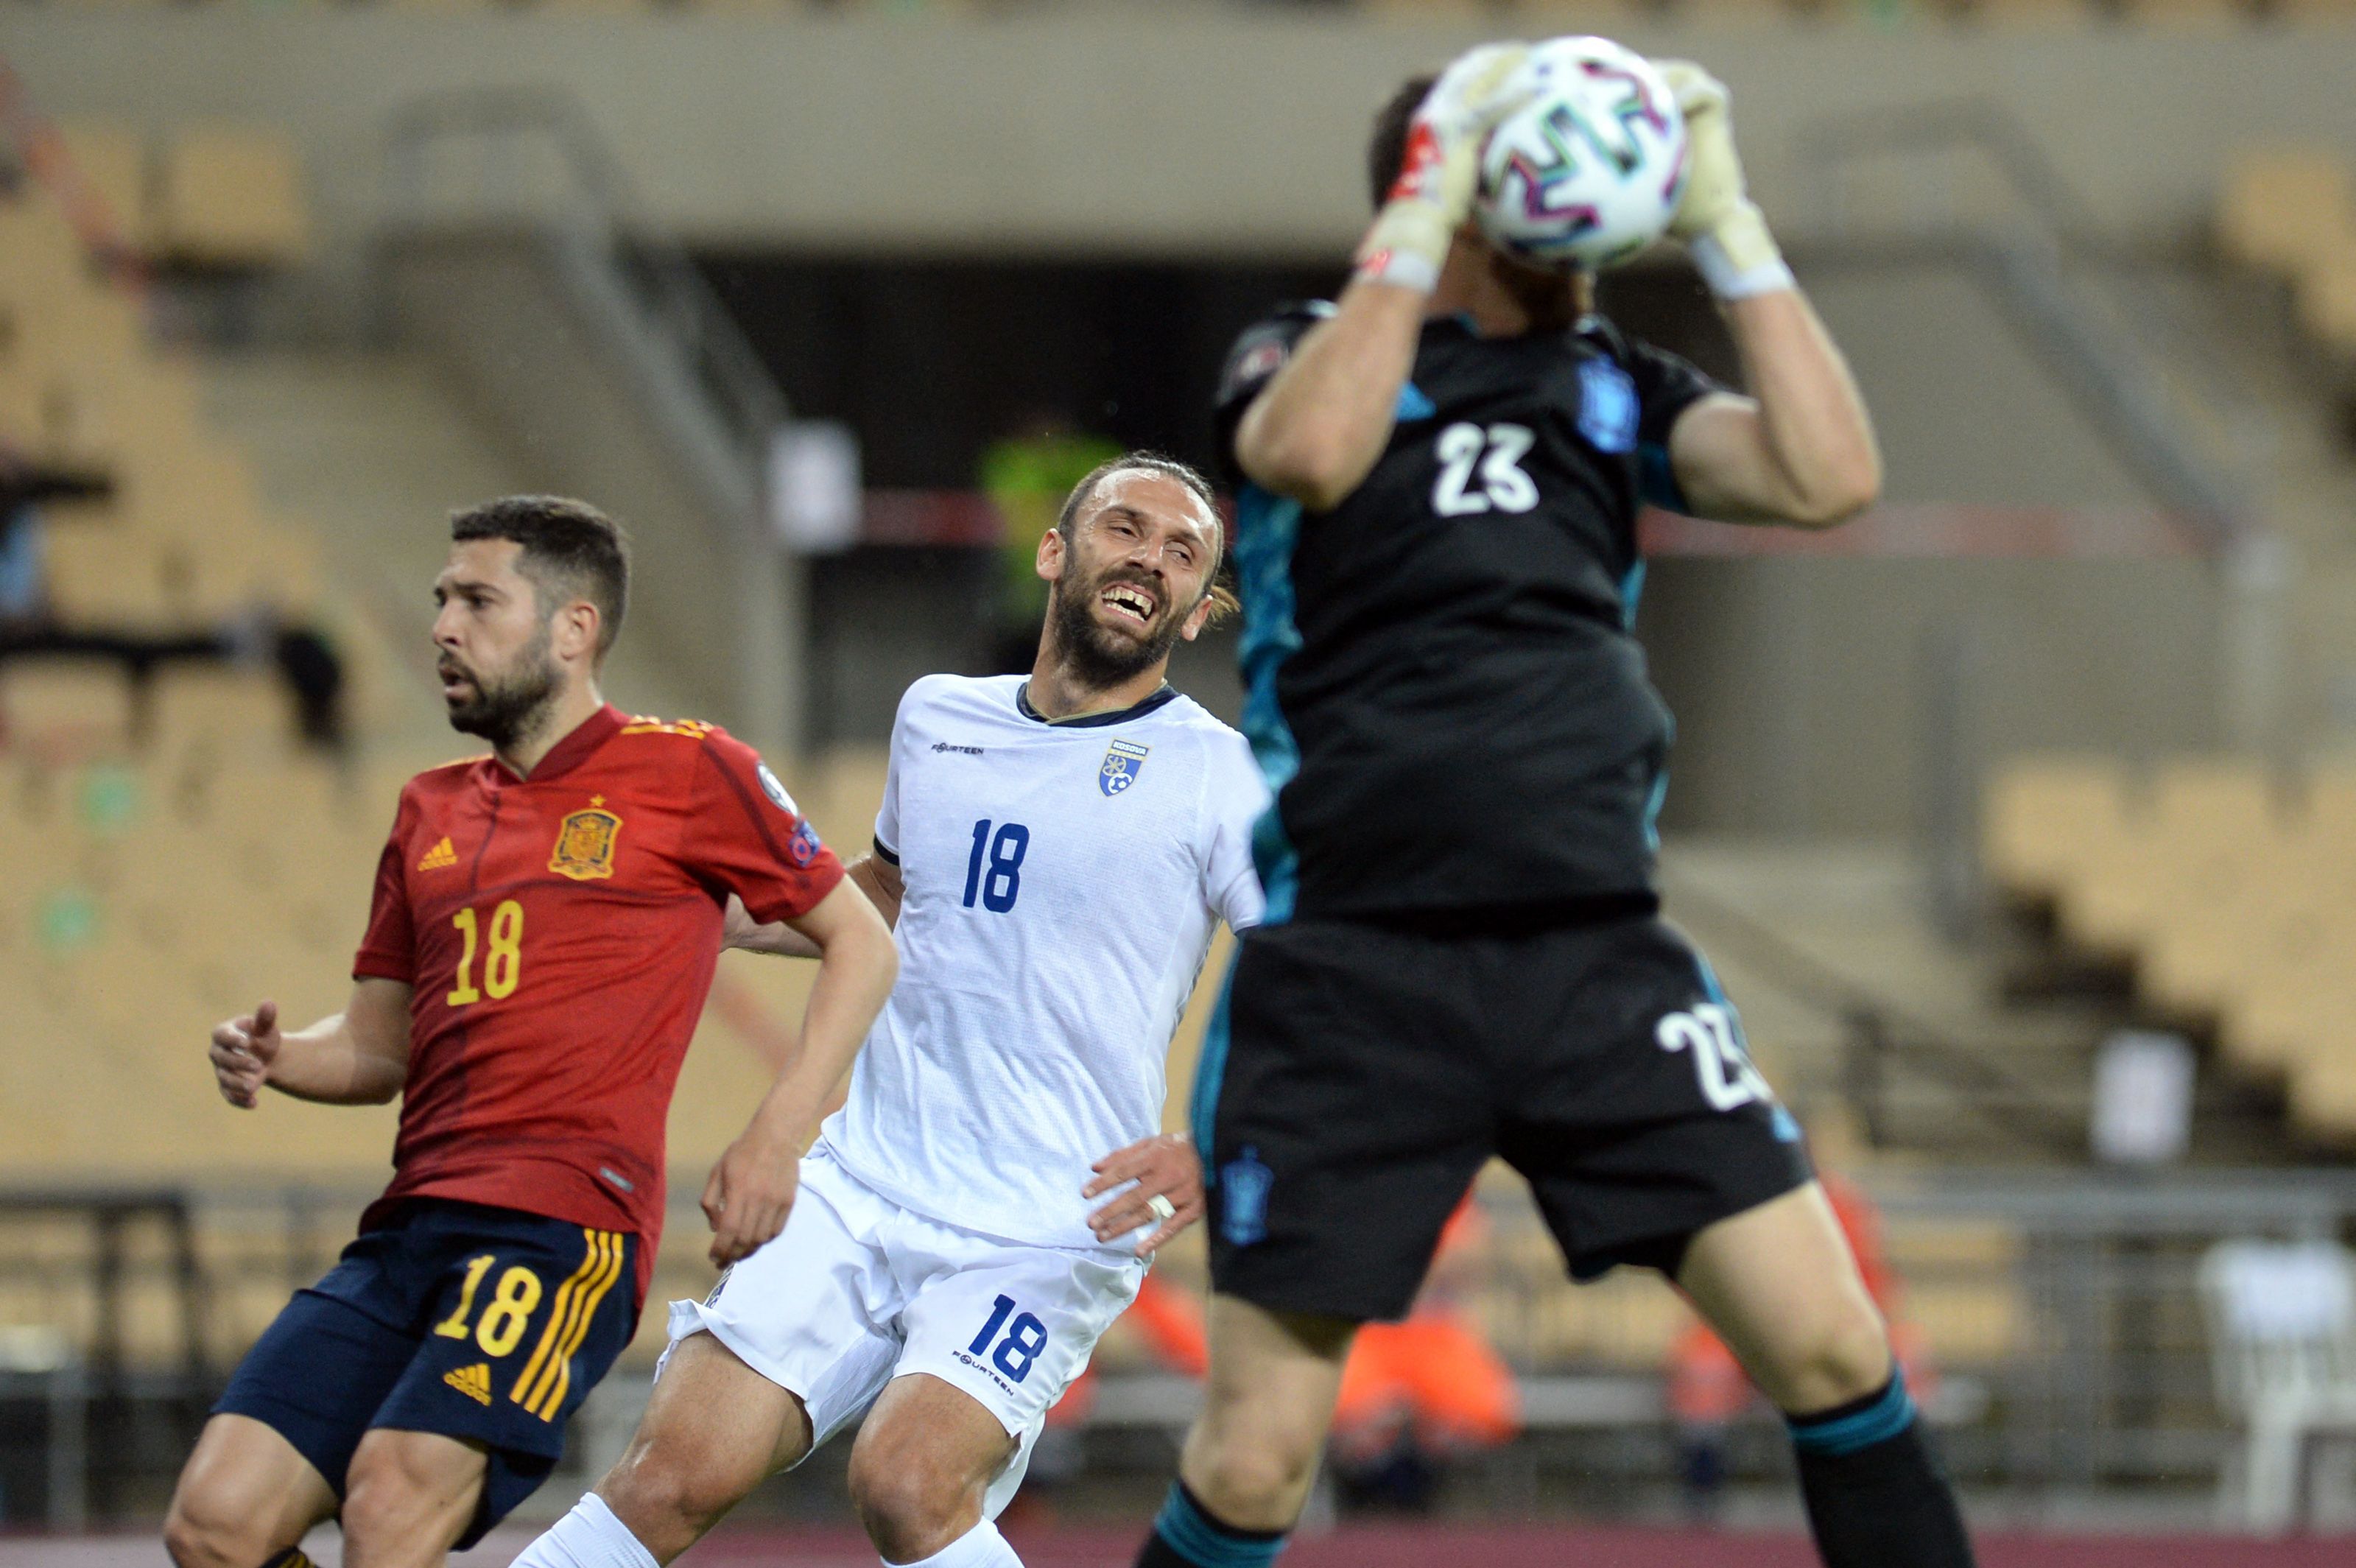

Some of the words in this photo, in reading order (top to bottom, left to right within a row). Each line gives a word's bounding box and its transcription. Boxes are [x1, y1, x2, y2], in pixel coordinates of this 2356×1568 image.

[1432, 421, 1539, 518] 23
[930, 742, 985, 755] FOURTEEN
[1113, 740, 1147, 756] KOSOVA
[963, 818, 1030, 913] 18
[446, 899, 524, 1007] 18
[433, 1254, 543, 1357] 18
[968, 1293, 1048, 1384] 18
[952, 1349, 1016, 1397] FOURTEEN
